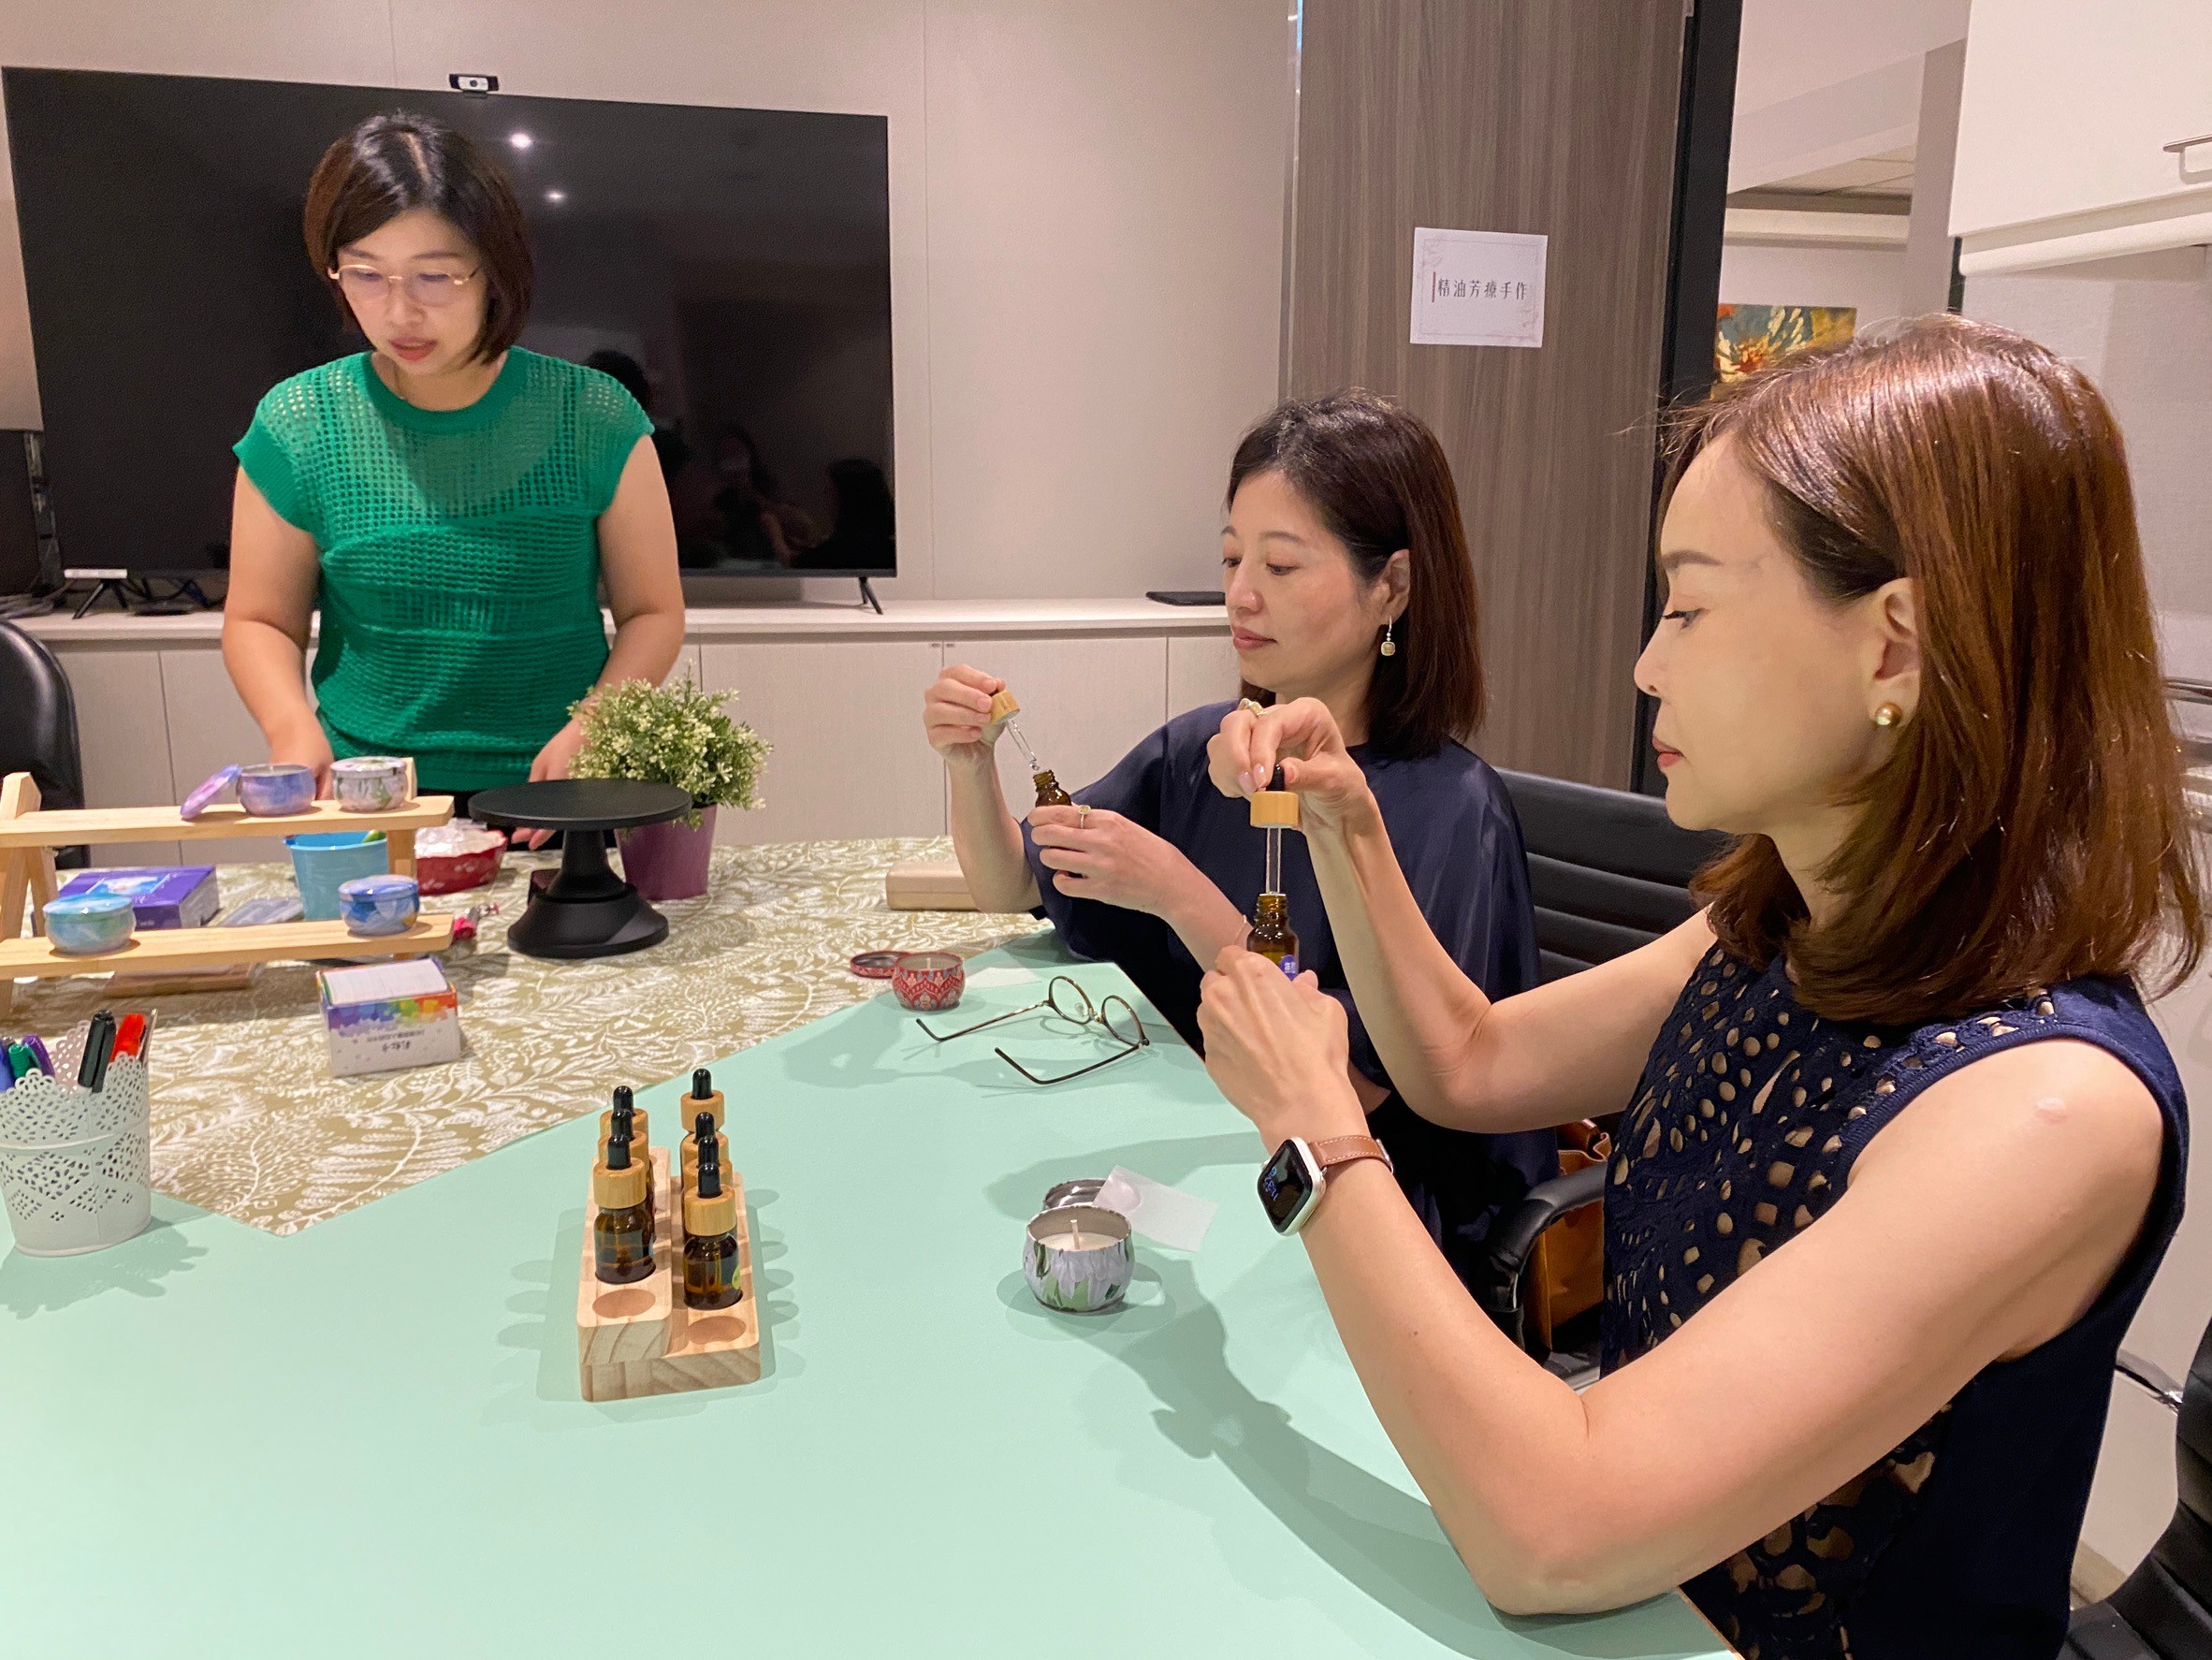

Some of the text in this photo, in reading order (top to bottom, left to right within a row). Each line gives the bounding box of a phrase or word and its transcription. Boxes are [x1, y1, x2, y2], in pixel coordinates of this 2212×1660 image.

[1437, 278, 1527, 299] 精油芳療手作
